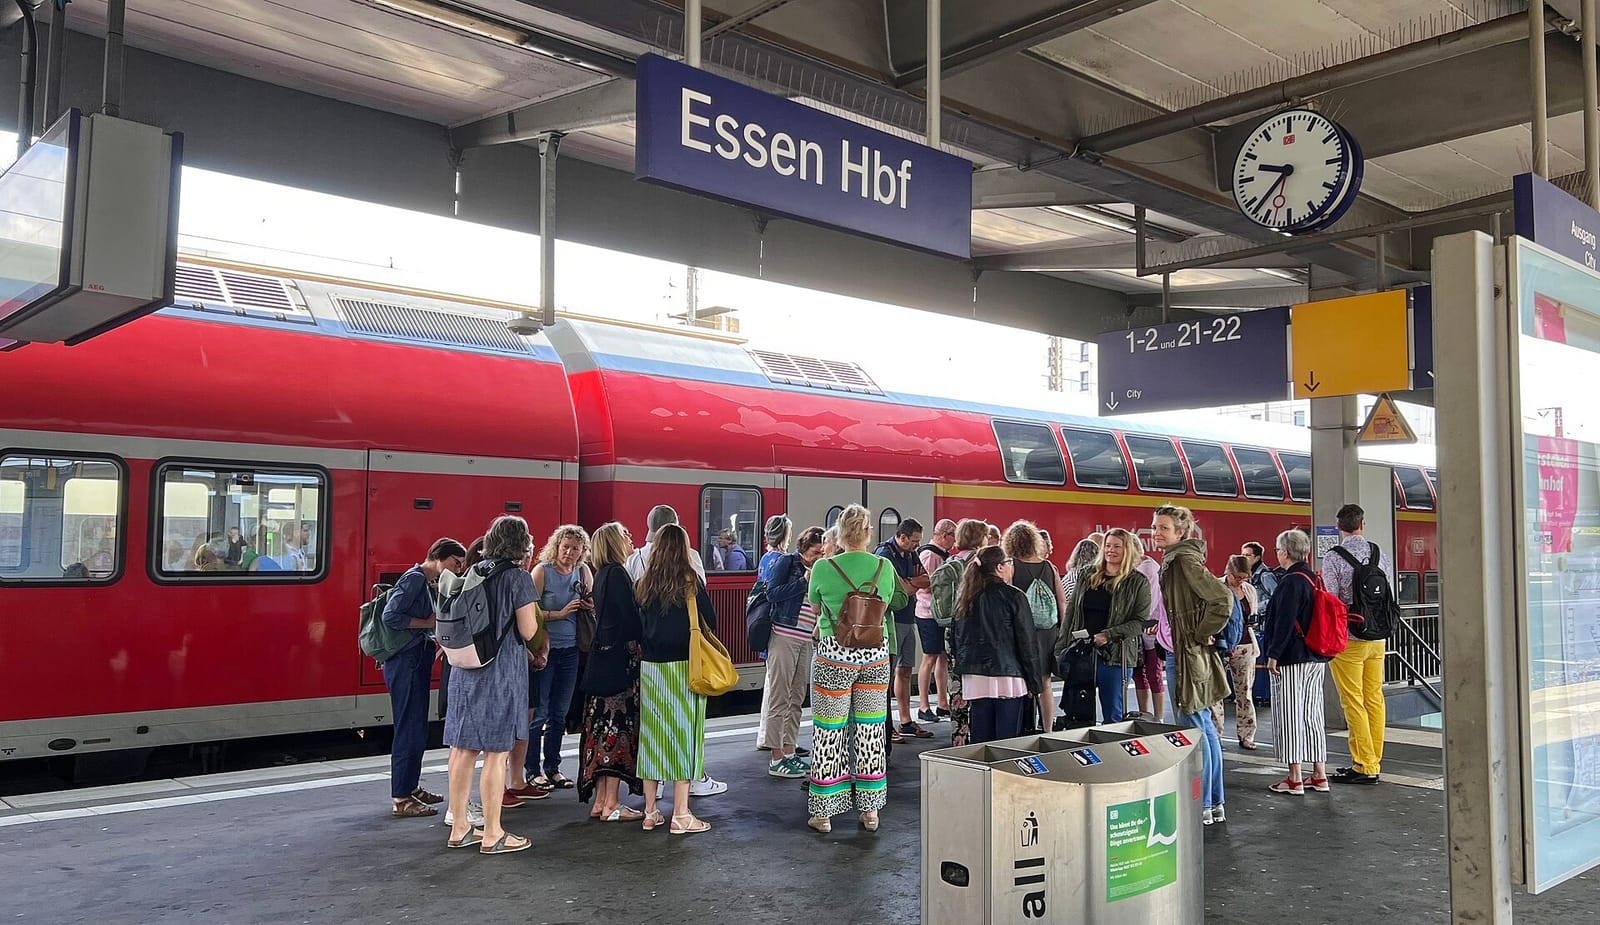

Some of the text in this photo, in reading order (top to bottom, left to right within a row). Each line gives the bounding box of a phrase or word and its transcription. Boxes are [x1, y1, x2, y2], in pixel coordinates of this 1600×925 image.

[681, 87, 912, 209] Essen Hbf
[1571, 219, 1596, 250] Ausgang
[88, 283, 105, 291] AEG
[1126, 316, 1241, 353] 1-2 und 21-22
[1126, 388, 1142, 399] City
[1015, 857, 1046, 918] all
